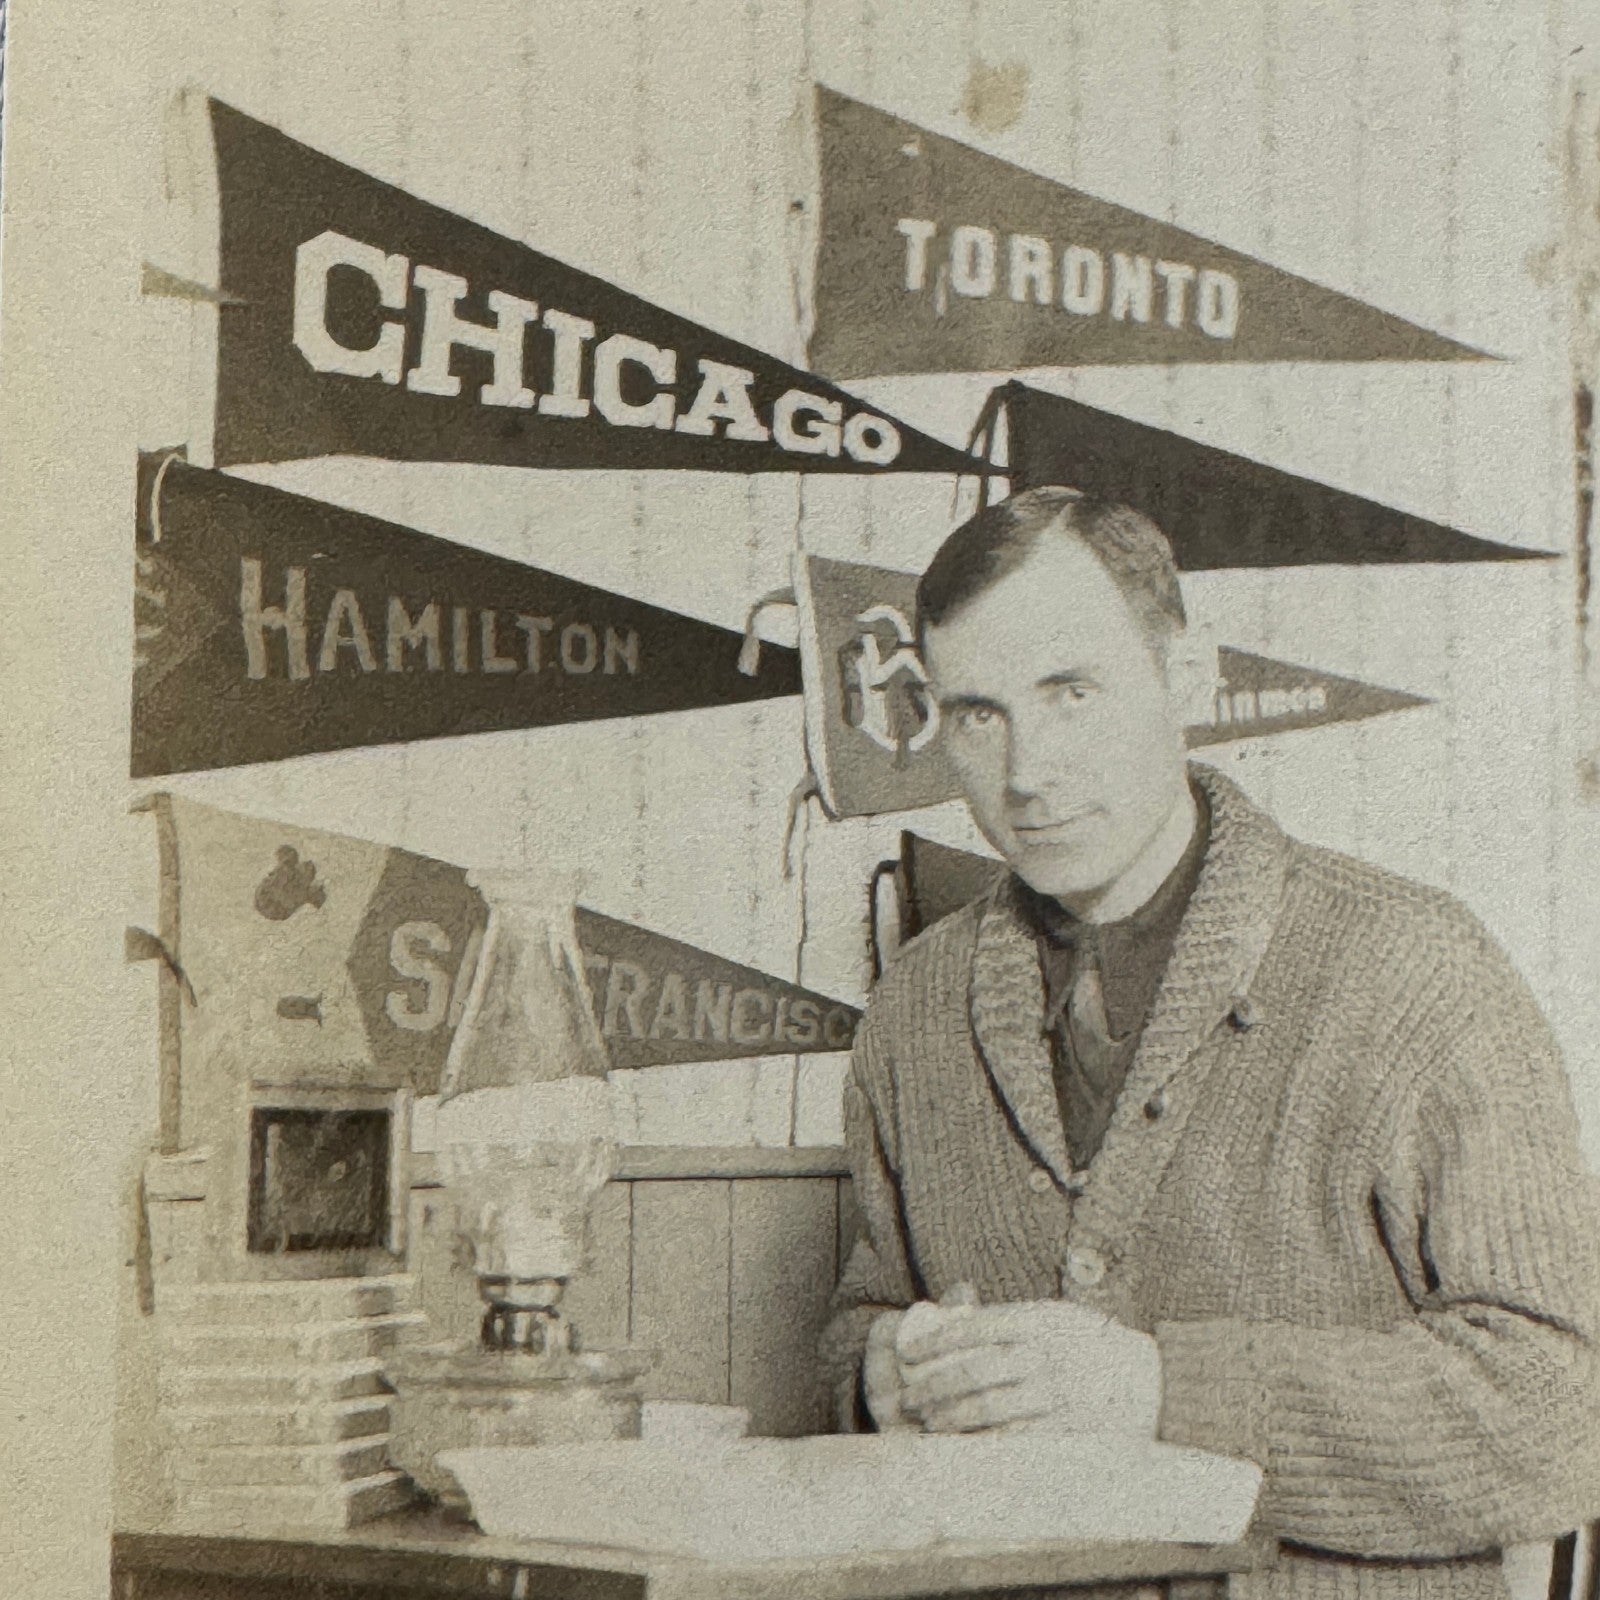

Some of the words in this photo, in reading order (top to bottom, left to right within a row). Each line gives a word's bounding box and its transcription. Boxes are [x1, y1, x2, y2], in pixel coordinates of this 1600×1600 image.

[897, 217, 1240, 339] TORONTO
[292, 229, 903, 467] CHICAGO
[239, 557, 641, 682] HAMILTON
